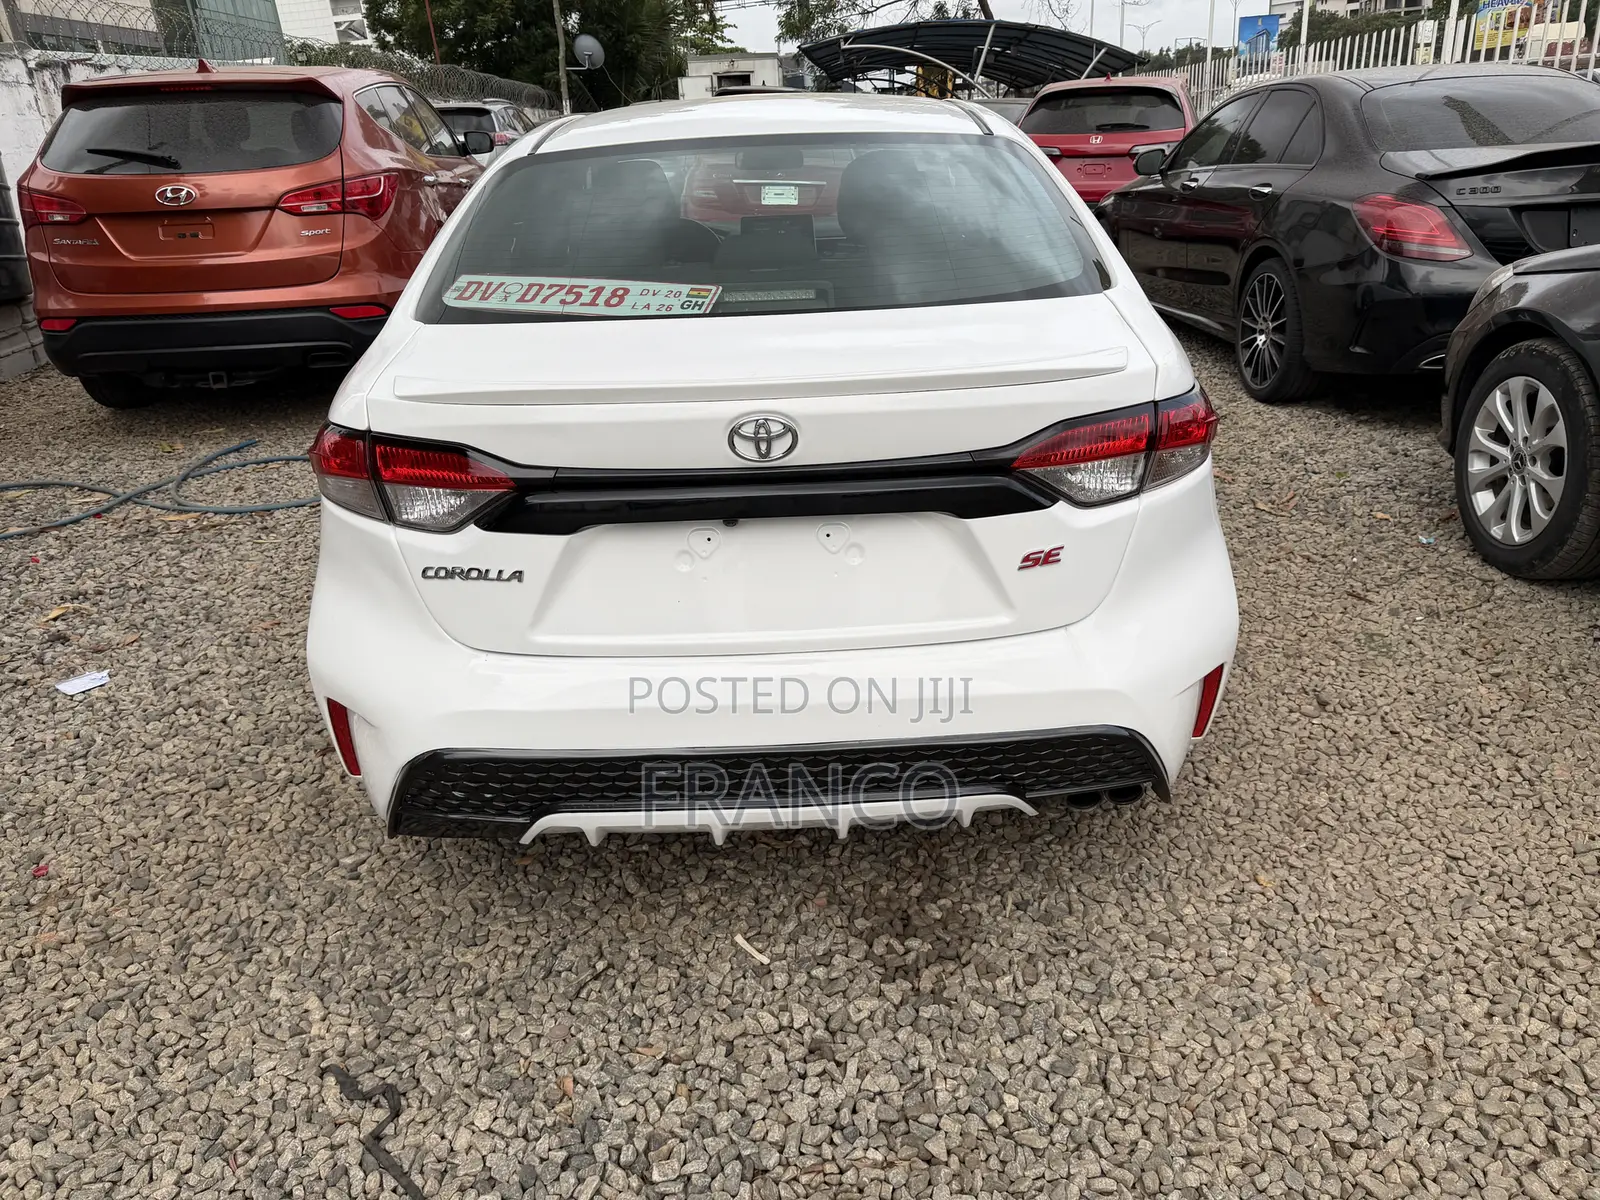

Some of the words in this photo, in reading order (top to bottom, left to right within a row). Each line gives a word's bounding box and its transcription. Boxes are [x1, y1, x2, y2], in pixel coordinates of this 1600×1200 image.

[1456, 187, 1466, 195] C
[1468, 186, 1501, 195] 300
[300, 228, 331, 236] Sport
[455, 281, 506, 301] DV
[515, 282, 631, 308] D7518
[640, 288, 661, 296] DV
[664, 290, 682, 299] 20
[631, 302, 650, 310] LA
[656, 303, 674, 312] 26
[680, 300, 706, 311] GH
[1017, 543, 1064, 571] SE
[421, 566, 524, 583] COROLLA
